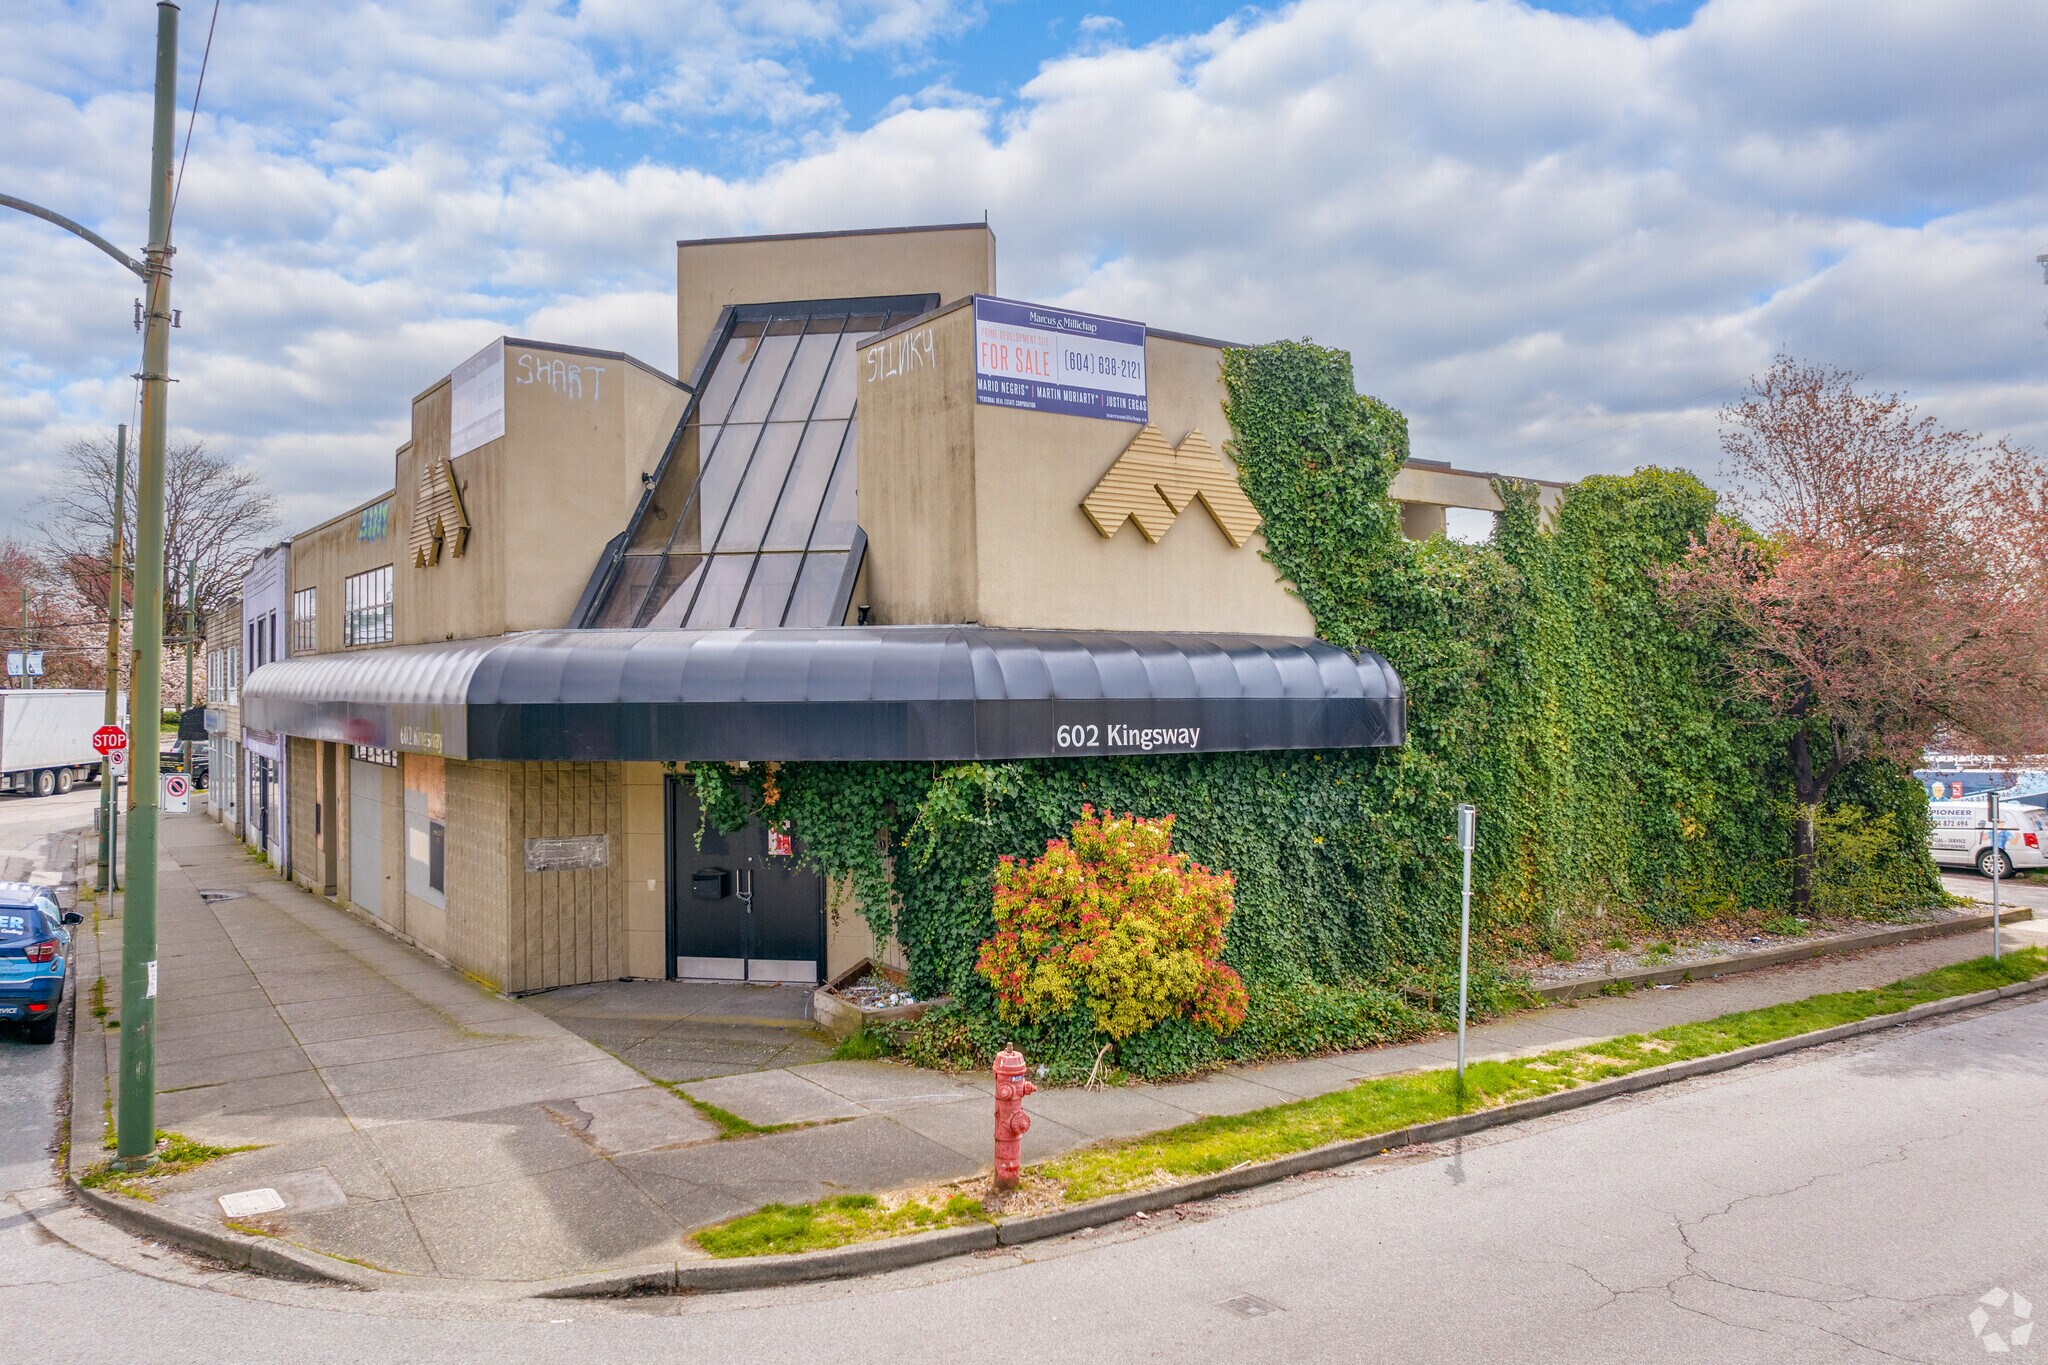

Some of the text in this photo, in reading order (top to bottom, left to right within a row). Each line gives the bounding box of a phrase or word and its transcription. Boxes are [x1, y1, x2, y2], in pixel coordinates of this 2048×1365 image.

[1030, 312, 1056, 325] Marcus
[1063, 317, 1097, 333] Millichap
[981, 328, 1049, 346] PRIME DEVELOPMENT SITE
[982, 342, 1050, 377] FOR SALE
[1064, 350, 1142, 380] (604) 638-2121
[516, 354, 606, 400] SHART
[977, 378, 999, 393] MARIO
[1036, 386, 1061, 401] MARTIN
[1106, 395, 1147, 412] JUSTIN ERGAS
[94, 734, 126, 747] STOP
[400, 726, 412, 745] 602
[1056, 724, 1200, 750] 602 Kingsway
